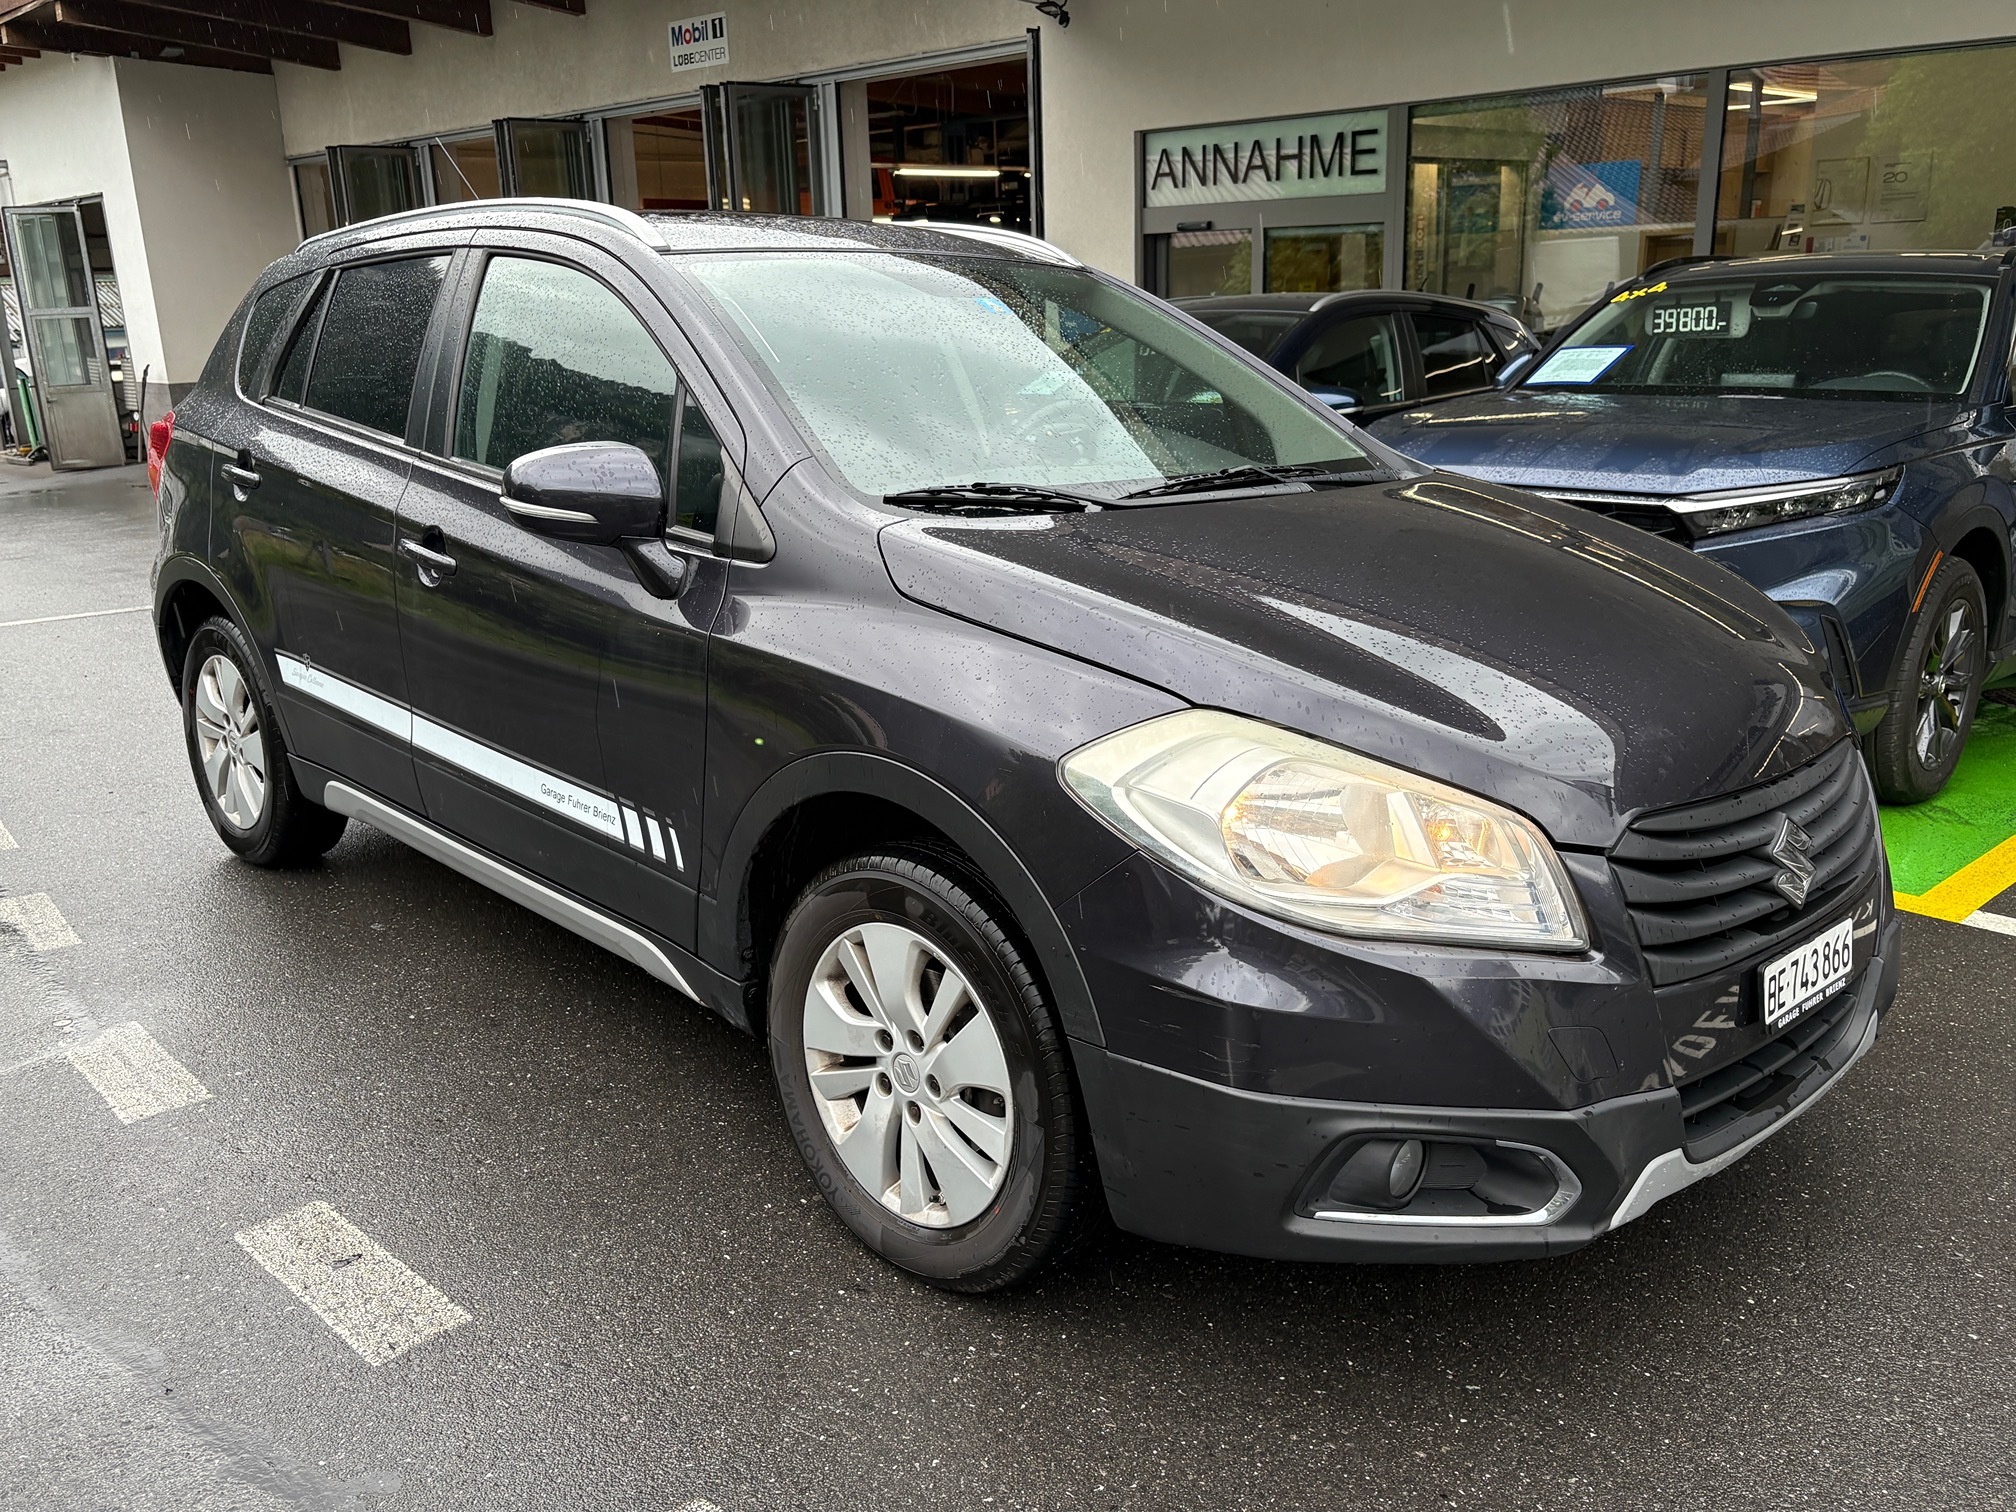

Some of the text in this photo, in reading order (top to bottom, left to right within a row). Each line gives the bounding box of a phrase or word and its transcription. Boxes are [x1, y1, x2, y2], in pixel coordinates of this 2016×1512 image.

[671, 18, 722, 47] Mobil 1
[1151, 128, 1378, 190] ANNAHME
[1610, 281, 1668, 303] 4x4
[541, 783, 565, 804] Garage
[593, 806, 616, 826] Brienz
[1778, 1008, 1800, 1029] GARAGE
[1826, 977, 1847, 998] BRIENZ
[780, 1073, 840, 1202] YOKOHAMA
